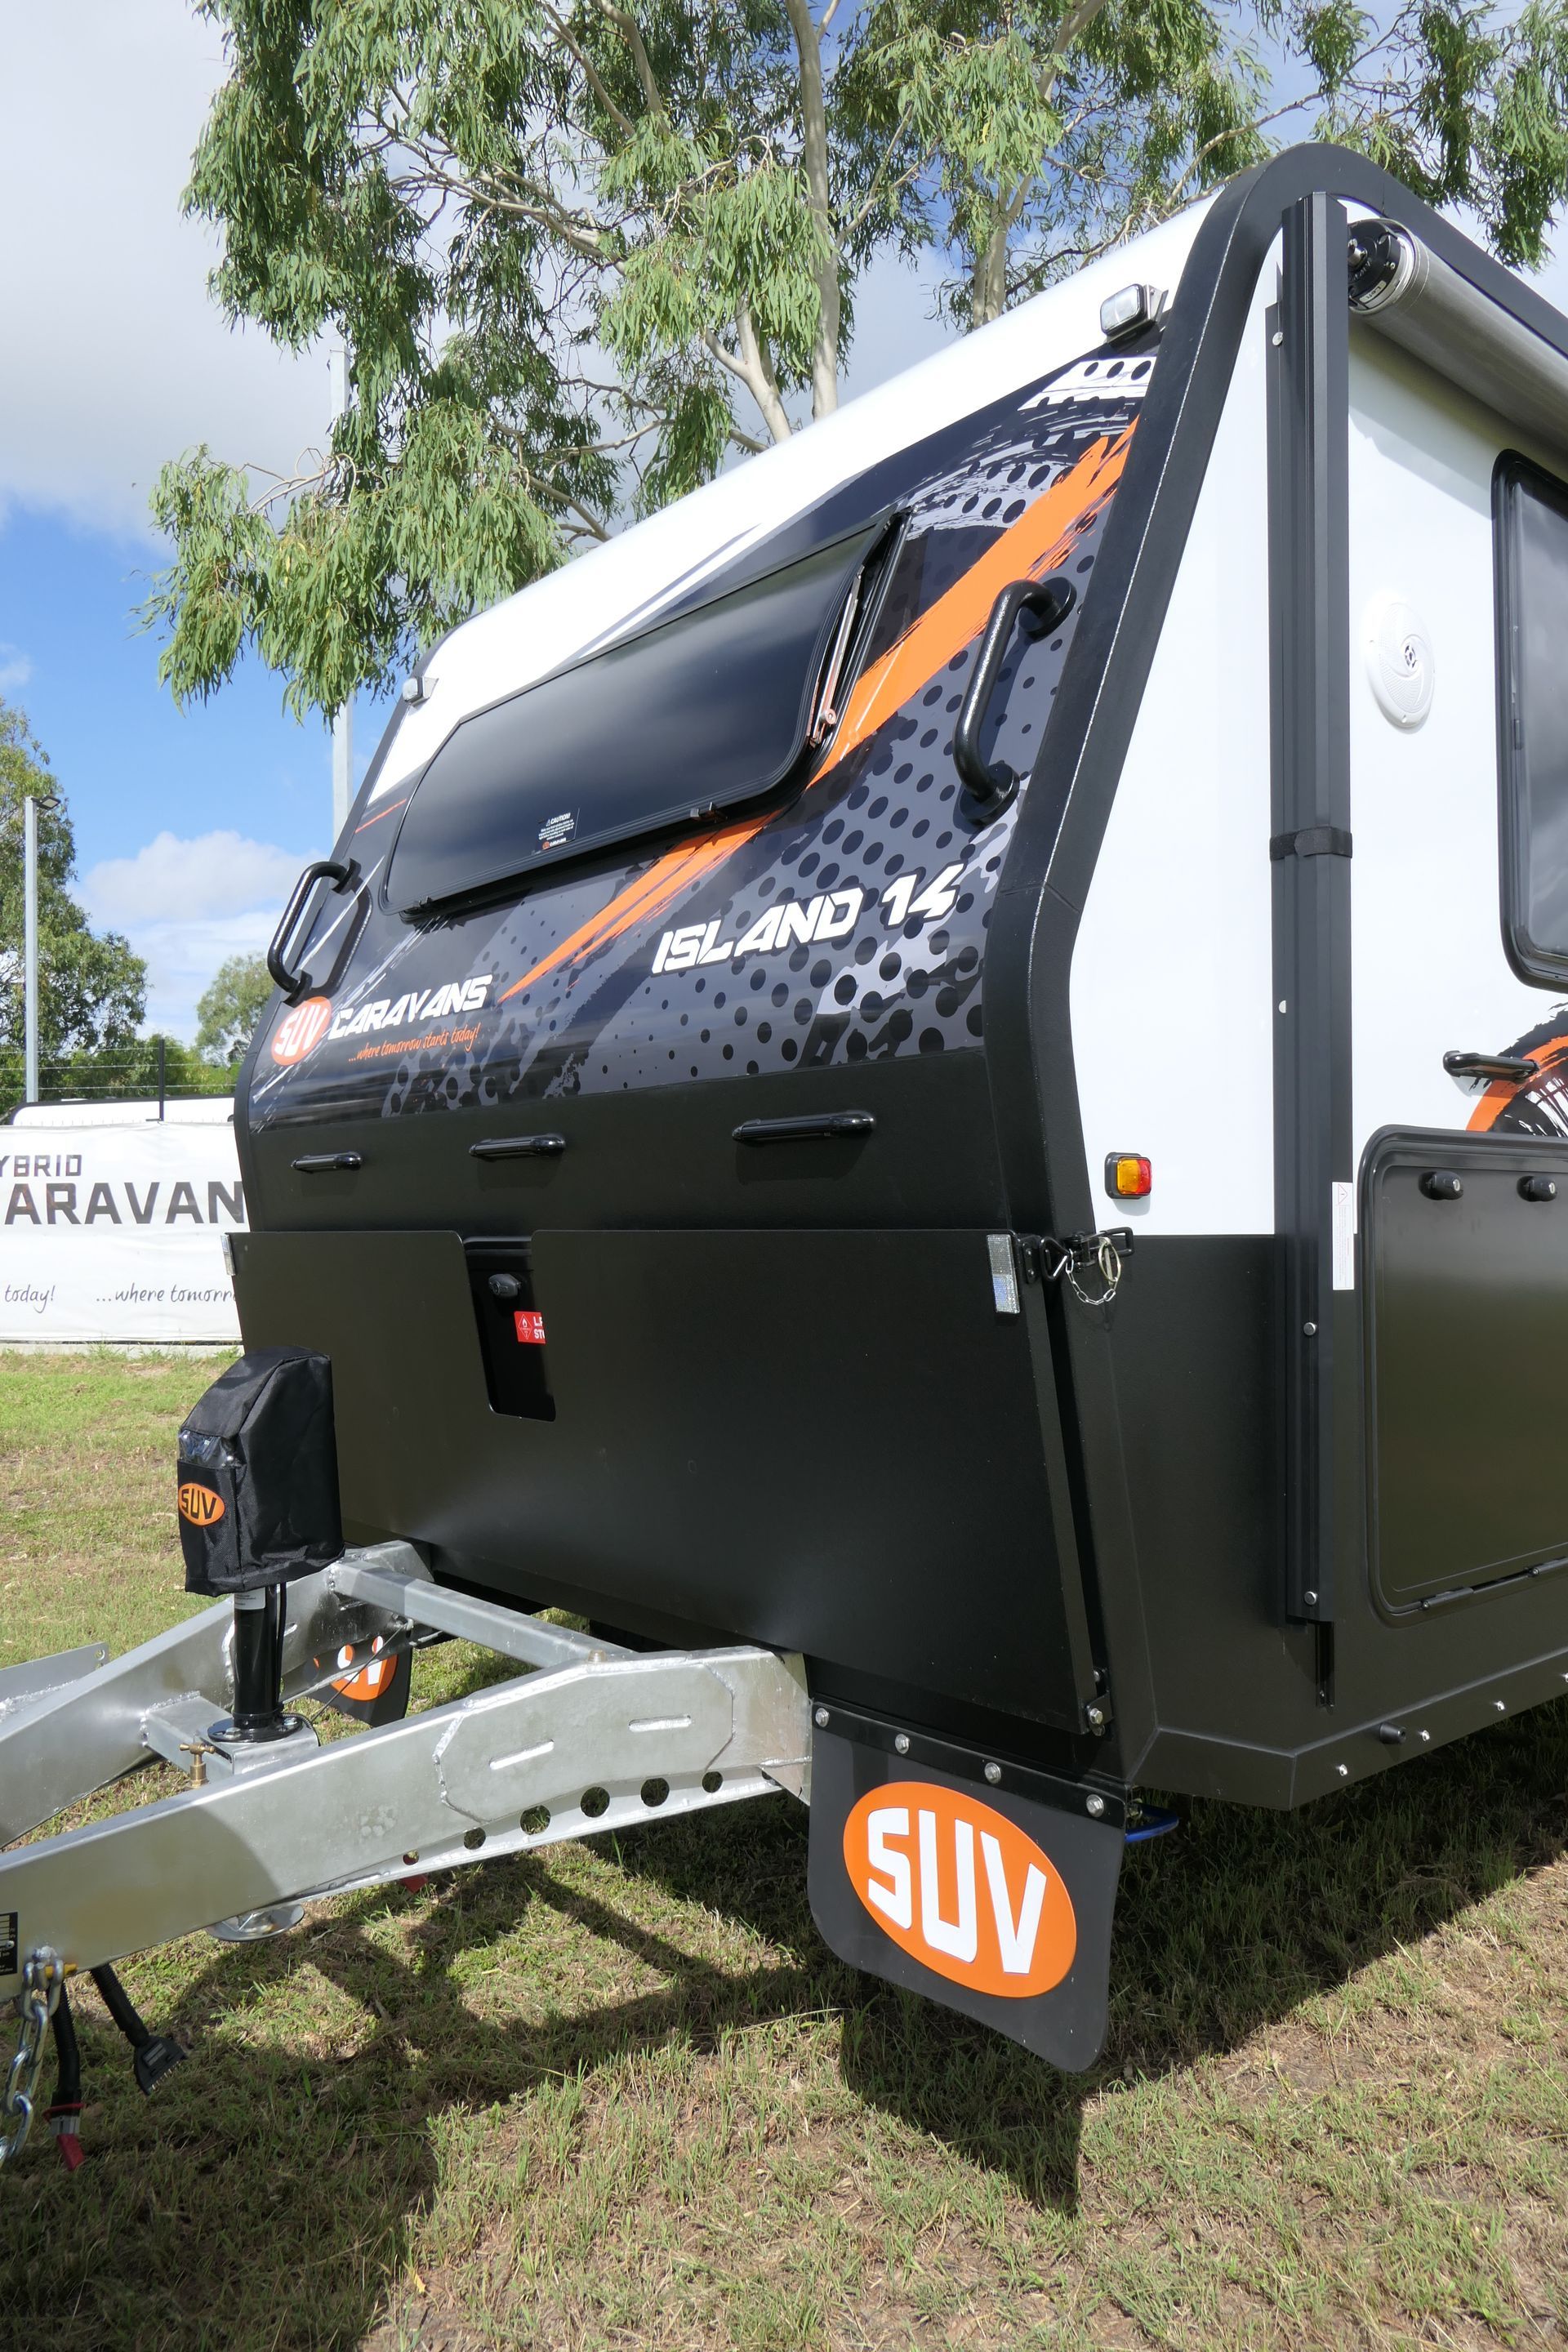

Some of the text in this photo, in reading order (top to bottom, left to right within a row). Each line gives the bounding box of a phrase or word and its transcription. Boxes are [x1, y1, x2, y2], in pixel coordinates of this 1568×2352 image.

[651, 862, 965, 974] ISLAND 14
[274, 1003, 328, 1057] SUV
[328, 974, 493, 1040] CARAVANS
[381, 1038, 422, 1057] tomorrow
[422, 1028, 449, 1049] starts
[451, 1022, 482, 1052] today!
[5, 1285, 56, 1314] today!
[180, 1487, 217, 1520] SUV
[867, 1806, 1047, 1975] SUV
